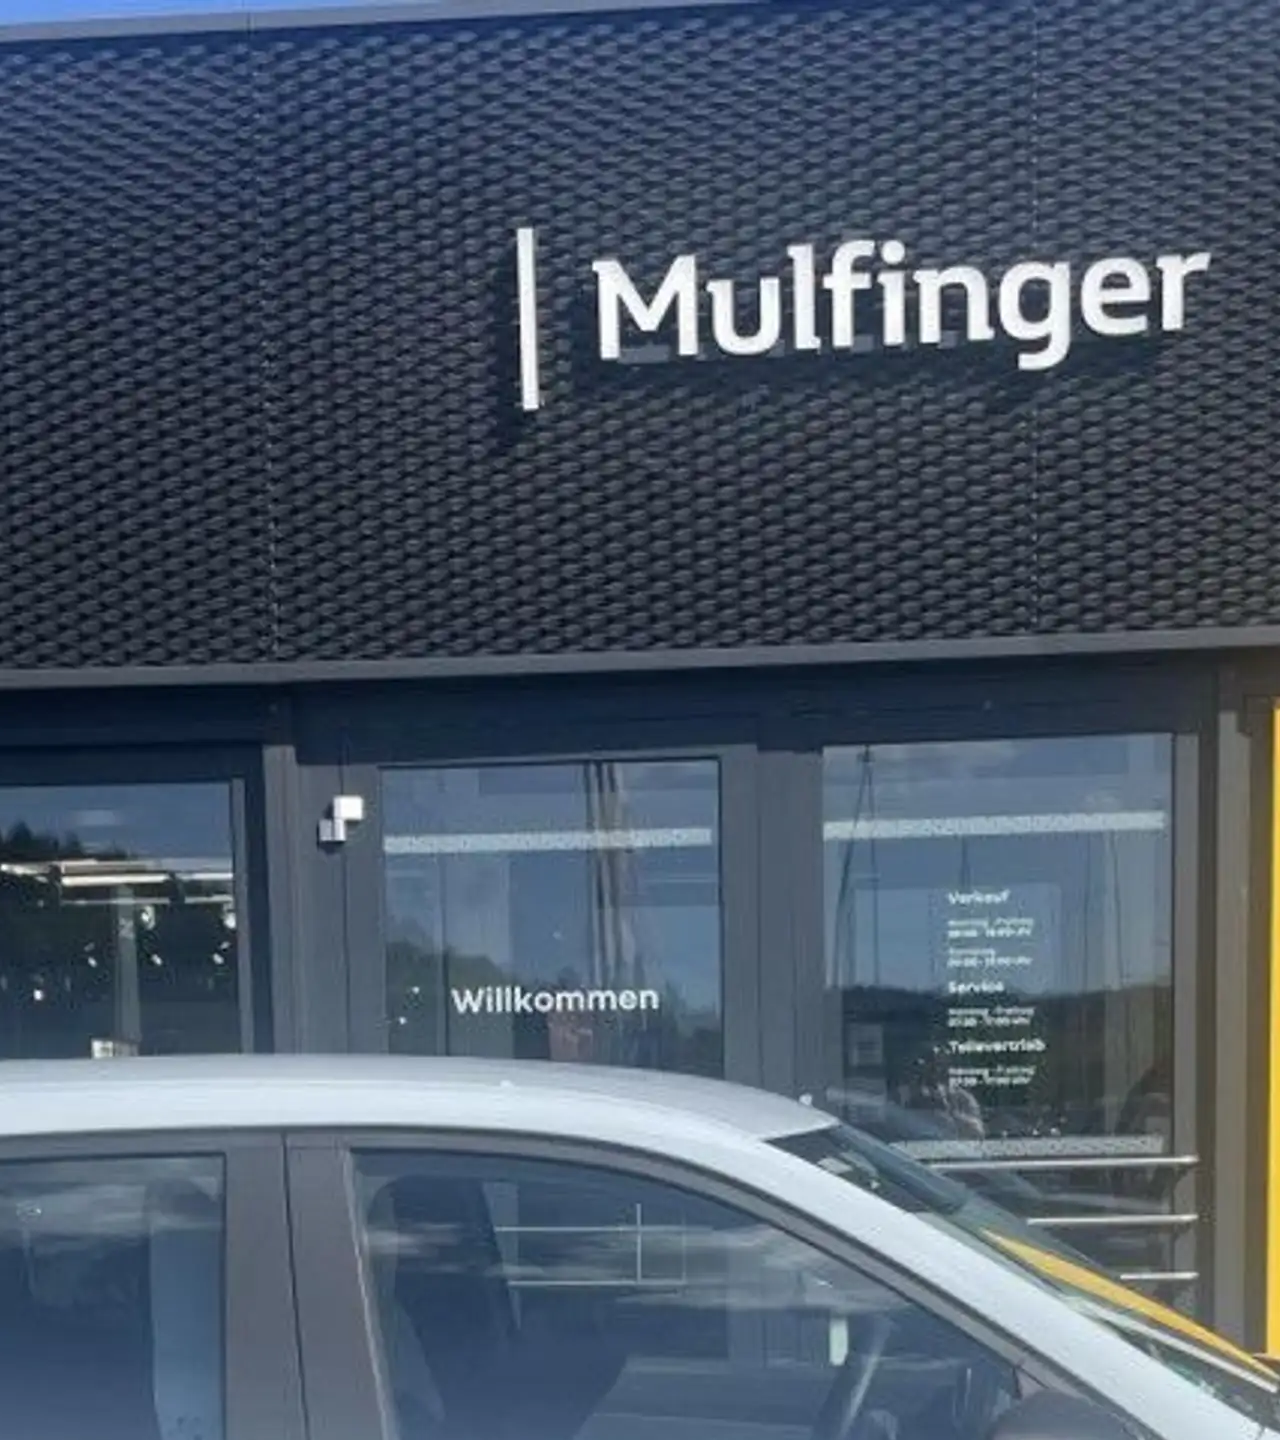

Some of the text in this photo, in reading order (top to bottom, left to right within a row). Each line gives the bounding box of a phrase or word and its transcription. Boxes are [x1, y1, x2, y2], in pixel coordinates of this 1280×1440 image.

[592, 239, 1210, 370] Mulfinger
[948, 888, 1011, 904] Verkauf
[948, 980, 1004, 995] Service
[451, 985, 660, 1014] Willkommen
